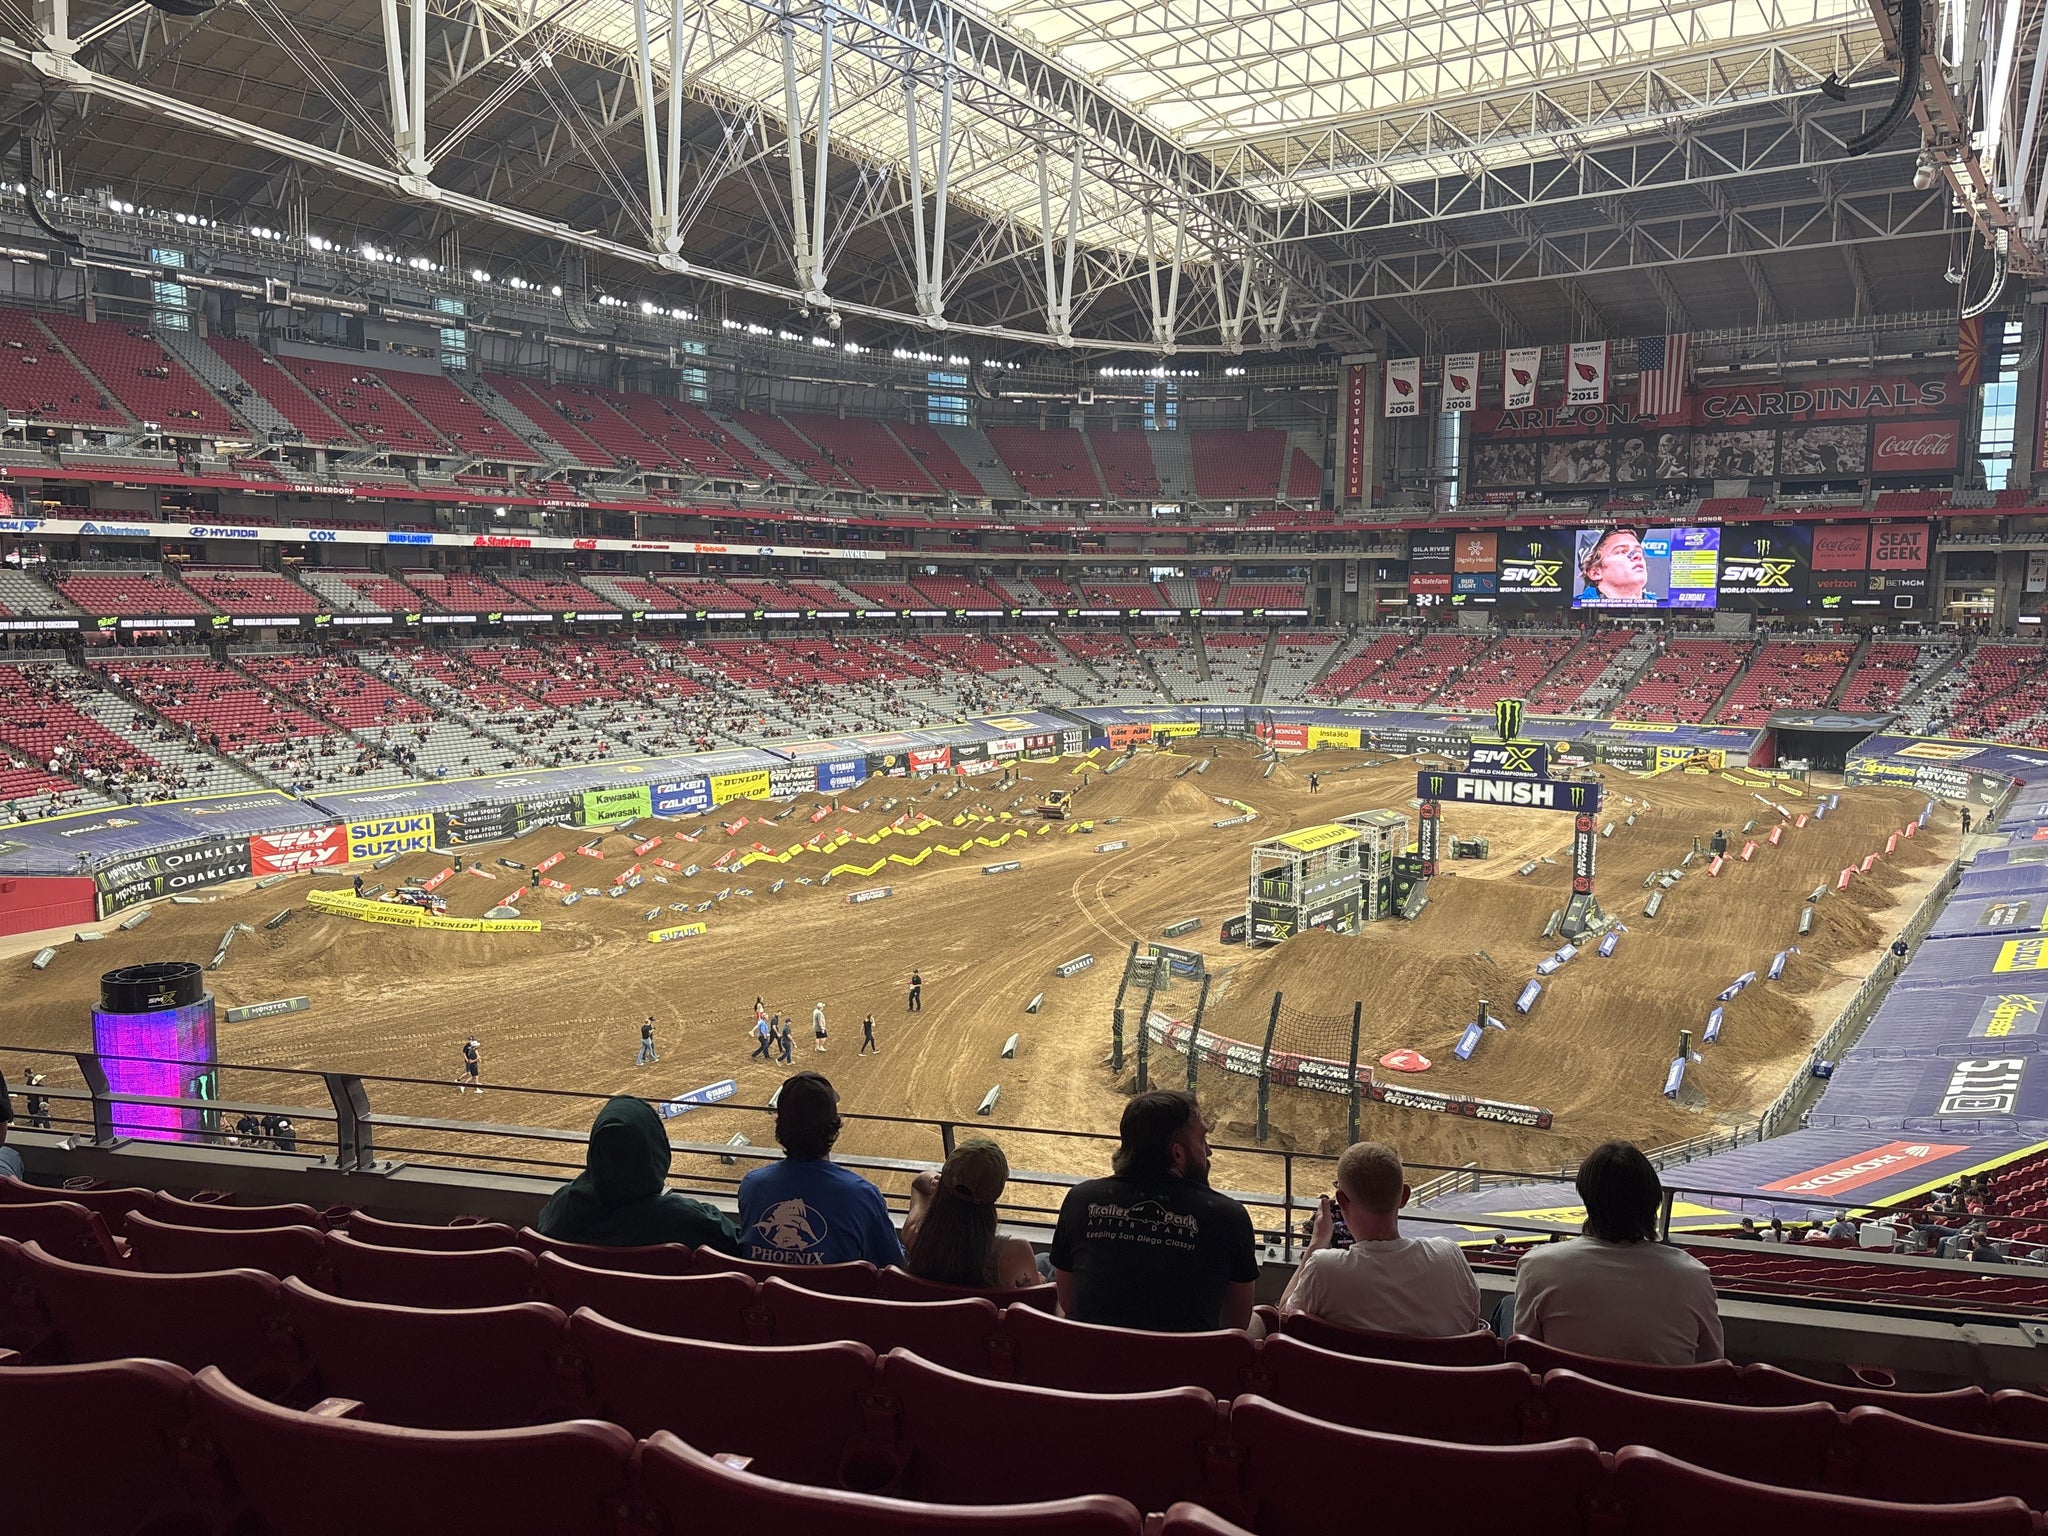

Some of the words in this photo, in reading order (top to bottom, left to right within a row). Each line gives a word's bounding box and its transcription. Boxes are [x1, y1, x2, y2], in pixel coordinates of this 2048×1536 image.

[1509, 396, 1530, 406] 2009
[1571, 391, 1599, 401] 2015
[1702, 381, 1947, 420] CARDINALS
[1389, 406, 1415, 414] 2008
[1445, 401, 1471, 409] 2008
[1353, 379, 1361, 454] FOOTBALL
[1877, 432, 1954, 458] Coca-Cola
[1351, 457, 1359, 494] CLUB
[314, 486, 355, 494] DIERDORF
[210, 528, 258, 538] HYUNDAI
[309, 530, 336, 541] COX
[388, 534, 407, 543] BUD
[407, 534, 432, 544] LIGHT
[1879, 532, 1922, 546] SEAT
[843, 550, 870, 559] AVNET
[1876, 547, 1922, 561] GEEK
[1456, 557, 1475, 565] Dignity
[1500, 564, 1560, 587] SMX
[1721, 563, 1793, 587] SMX
[1817, 578, 1857, 588] verizon
[1678, 593, 1706, 601] GLENDALE
[98, 616, 118, 627] BEAST
[212, 616, 231, 625] BEAST
[1430, 736, 1469, 744] OAKLEY
[1606, 745, 1644, 754] MONSTER
[1471, 746, 1538, 772] SMX
[1605, 757, 1643, 766] MONSTER
[835, 761, 855, 770] YAMAHA
[1863, 763, 1916, 776] alpinestars
[1927, 765, 1943, 773] ROCKY
[1943, 768, 1968, 777] MOUNTAIN
[724, 773, 766, 786] DUNLOP
[1491, 770, 1539, 778] CHAMPIONSHIP
[835, 775, 856, 786] YAMAHA
[1924, 780, 1941, 788] ROCKY
[1941, 783, 1967, 791] MOUNTAIN
[657, 780, 706, 794] FALKEN
[1456, 777, 1554, 806] FINISH
[596, 791, 640, 805] Kawasaki
[725, 787, 766, 801] DUNLOP
[214, 802, 239, 810] UTAH
[242, 798, 279, 807] SPORTS
[220, 801, 283, 812] COMMISSION
[528, 797, 572, 811] MONSTER
[659, 795, 708, 809] FALKEN
[480, 807, 501, 815] SPORTS
[597, 806, 641, 820] Kawasaki
[464, 813, 502, 823] COMMISSION
[351, 817, 431, 840] SUZUKI
[481, 824, 502, 833] SPORTS
[264, 827, 336, 848] FLY
[465, 830, 502, 841] COMMISSION
[1304, 827, 1348, 846] DUNLOP
[279, 842, 324, 852] RACING
[352, 836, 432, 858] SUZUKI
[640, 839, 655, 851] FLY
[185, 843, 246, 863] OAKLEY
[265, 846, 340, 868] FLY
[279, 862, 326, 872] RACING
[543, 856, 559, 868] FLY
[107, 861, 146, 880] MONSTER
[188, 863, 248, 884] OAKLEY
[429, 871, 446, 887] FLY
[550, 880, 566, 889] FLY
[115, 881, 152, 901] MONSTER
[335, 897, 370, 910] DUNLOP
[504, 891, 521, 905] FLY
[335, 909, 364, 919] DUNLOP
[377, 906, 423, 916] DUNLOP
[376, 915, 416, 926] DUNLOP
[432, 921, 479, 930] DUNLOP
[494, 923, 538, 931] DUNLOP
[1255, 923, 1292, 940] SMX
[659, 925, 701, 942] SUZUKI
[1072, 957, 1095, 973] OAKLEY
[251, 1002, 288, 1014] MONSTER
[712, 1085, 732, 1097] YAMAHA
[1394, 1091, 1414, 1099] ROCKY
[1415, 1095, 1447, 1106] MOUNTAIN
[1487, 1106, 1506, 1114] ROCKY
[1507, 1109, 1539, 1118] MOUNTAIN
[1784, 1151, 1909, 1193] HONDA
[1088, 1203, 1130, 1218] Trailer
[1088, 1219, 1136, 1229] AFTER
[1151, 1225, 1195, 1238] DARK
[1086, 1230, 1117, 1240] Keeping
[1118, 1231, 1135, 1241] San
[1137, 1235, 1162, 1245] Diego
[1165, 1238, 1195, 1251] Classy!
[751, 1246, 825, 1265] PHOENIX
